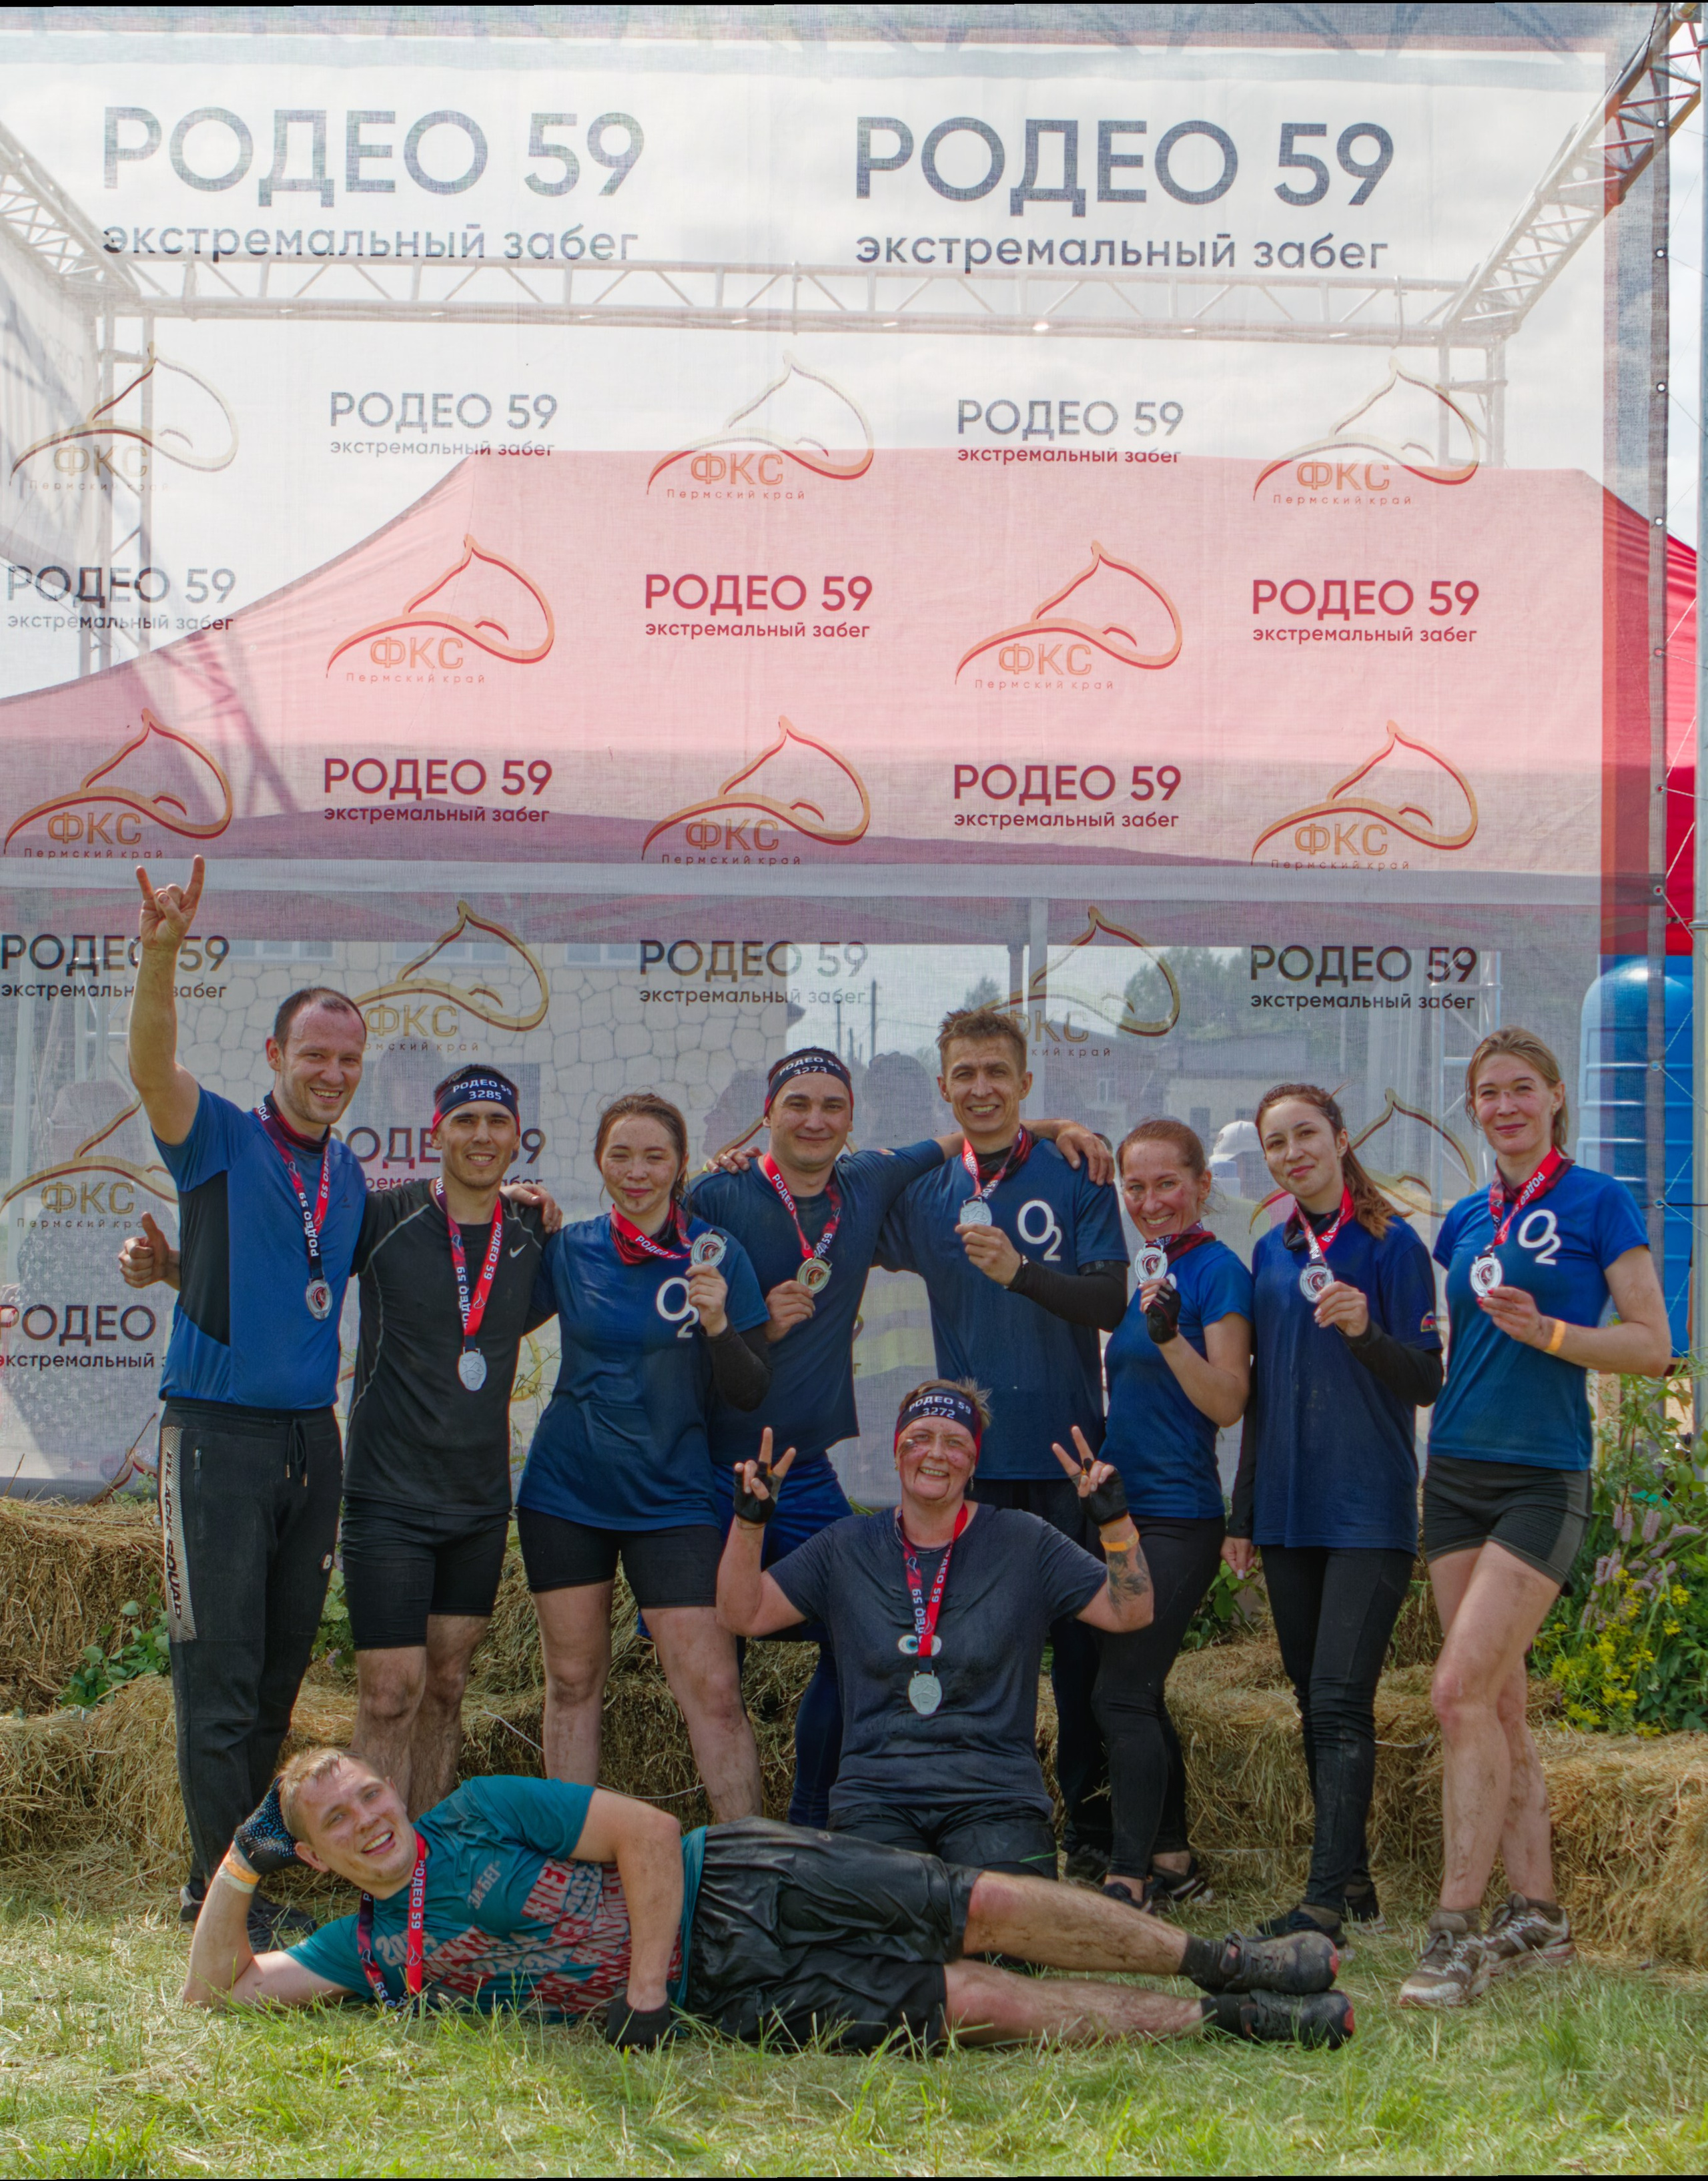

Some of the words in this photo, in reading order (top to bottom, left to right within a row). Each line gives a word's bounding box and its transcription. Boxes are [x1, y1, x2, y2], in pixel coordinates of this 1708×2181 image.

[104, 106, 489, 207] РОДЕО
[524, 111, 645, 197] 59
[857, 116, 1239, 218] РОДЕО
[1274, 122, 1394, 207] 59
[103, 222, 486, 263] экстремальный
[503, 224, 638, 260] забег
[856, 233, 1235, 274] экстремальный
[1253, 232, 1388, 270] забег
[330, 392, 492, 434] РОДЕО
[506, 394, 558, 431] 59
[958, 398, 1119, 441] РОДЕО
[1134, 401, 1185, 438] 59
[330, 438, 491, 459] экстремальный
[498, 439, 554, 458] забег
[957, 446, 1118, 466] экстремальный
[1124, 446, 1182, 465] забег
[53, 444, 149, 477] ФКС
[690, 452, 784, 486] ФКС
[1296, 458, 1390, 492] ФКС
[667, 488, 756, 502] Пермский
[763, 489, 806, 502] край
[1273, 494, 1362, 506] Пермский
[1369, 496, 1412, 506] край
[8, 565, 170, 608] РОДЕО
[185, 568, 236, 604] 59
[645, 573, 807, 616] РОДЕО
[821, 575, 873, 612] 59
[1253, 578, 1414, 621] РОДЕО
[1428, 580, 1480, 616] 59
[7, 614, 169, 633] экстремальный
[176, 614, 234, 631] забег
[645, 620, 806, 640] экстремальный
[812, 620, 870, 640] забег
[1253, 626, 1413, 644] экстремальный
[1420, 626, 1477, 642] забег
[370, 636, 464, 670] ФКС
[997, 642, 1093, 677] ФКС
[346, 672, 435, 685] Пермский
[443, 674, 485, 685] край
[975, 679, 1065, 692] Пермский
[1071, 679, 1114, 692] край
[324, 757, 488, 801] РОДЕО
[500, 759, 553, 797] 59
[954, 764, 1116, 807] РОДЕО
[1130, 765, 1182, 801] 59
[324, 805, 486, 825] экстремальный
[492, 805, 550, 823] забег
[953, 811, 1115, 830] экстремальный
[1122, 811, 1179, 827] забег
[47, 811, 142, 845] ФКС
[685, 818, 779, 851] ФКС
[1294, 823, 1388, 857] ФКС
[24, 847, 113, 860] Пермский
[121, 849, 163, 860] край
[661, 853, 751, 866] Пермский
[758, 855, 801, 866] край
[1270, 859, 1359, 872] Пермский
[1366, 860, 1410, 872] край
[177, 935, 231, 972] 59
[640, 939, 803, 983] РОДЕО
[817, 941, 868, 978] 59
[1250, 945, 1412, 987] РОДЕО
[1426, 947, 1478, 983] 59
[1, 982, 135, 1001] экстремальн
[639, 987, 801, 1006] экстремальный
[808, 987, 865, 1005] забег
[1250, 993, 1412, 1012] экстремальный
[1418, 993, 1475, 1010] забег
[363, 1004, 458, 1037] ФКС
[436, 1042, 478, 1053] край
[1068, 1047, 1111, 1059] край
[779, 1057, 824, 1076] РОДЕО
[452, 1079, 498, 1094] РОДЕО
[468, 1089, 502, 1101] 3285
[331, 1127, 441, 1170] ОДЕ
[41, 1181, 135, 1215] ФКС
[320, 1185, 329, 1200] 59
[772, 1174, 795, 1212] РОДЕО
[1520, 1171, 1546, 1206] РОДЕО
[299, 1192, 310, 1208] 59
[17, 1217, 106, 1230] Пермский
[304, 1211, 320, 1258] РОДЕО
[488, 1222, 502, 1263] РОДЕО
[635, 1234, 669, 1256] РОДЕО
[821, 1232, 833, 1244] 59
[456, 1266, 467, 1283] 59
[484, 1264, 495, 1281] 59
[0, 1304, 157, 1347] РОДЕО
[909, 1396, 954, 1412] РОДЕО
[957, 1401, 972, 1414] 59
[922, 1406, 956, 1420] 3272
[166, 1538, 183, 1621] SQUAD
[911, 1588, 923, 1604] 59
[931, 1587, 942, 1603] 59
[412, 1859, 426, 1908] РОДЕО
[411, 1911, 422, 1929] 59
[374, 1981, 390, 2000] 59
